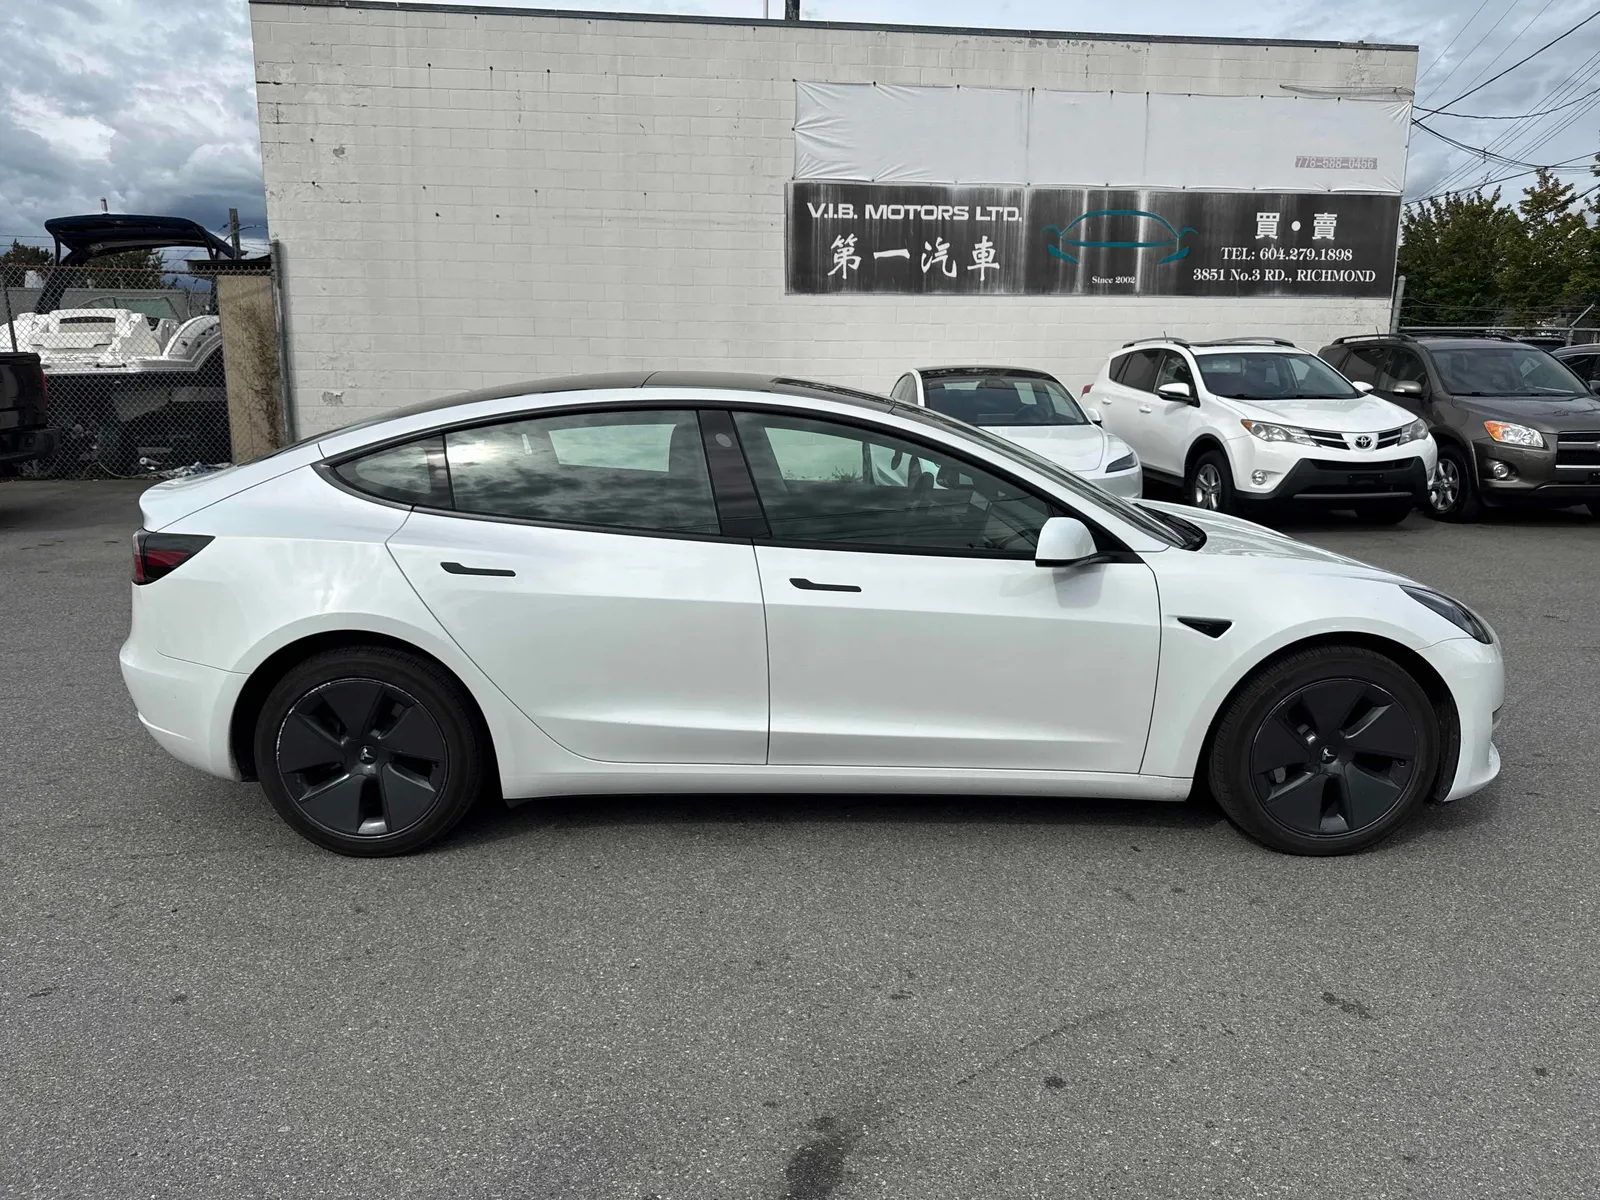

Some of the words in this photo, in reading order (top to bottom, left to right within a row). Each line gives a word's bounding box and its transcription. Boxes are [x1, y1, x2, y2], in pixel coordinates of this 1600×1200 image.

[1297, 157, 1374, 169] 778-588-0456
[807, 202, 858, 220] V.I.B.
[864, 204, 969, 221] MOTORS
[975, 206, 1022, 222] LTD.
[827, 233, 1001, 281] 第一汽車
[1221, 246, 1256, 261] TEL:
[1259, 247, 1353, 262] 604.279.1898
[1091, 275, 1113, 284] Since
[1115, 275, 1136, 284] 2002
[1193, 267, 1225, 281] 3851
[1229, 268, 1260, 282] No.3
[1264, 268, 1293, 284] RD.,
[1296, 269, 1376, 283] RICHMOND
